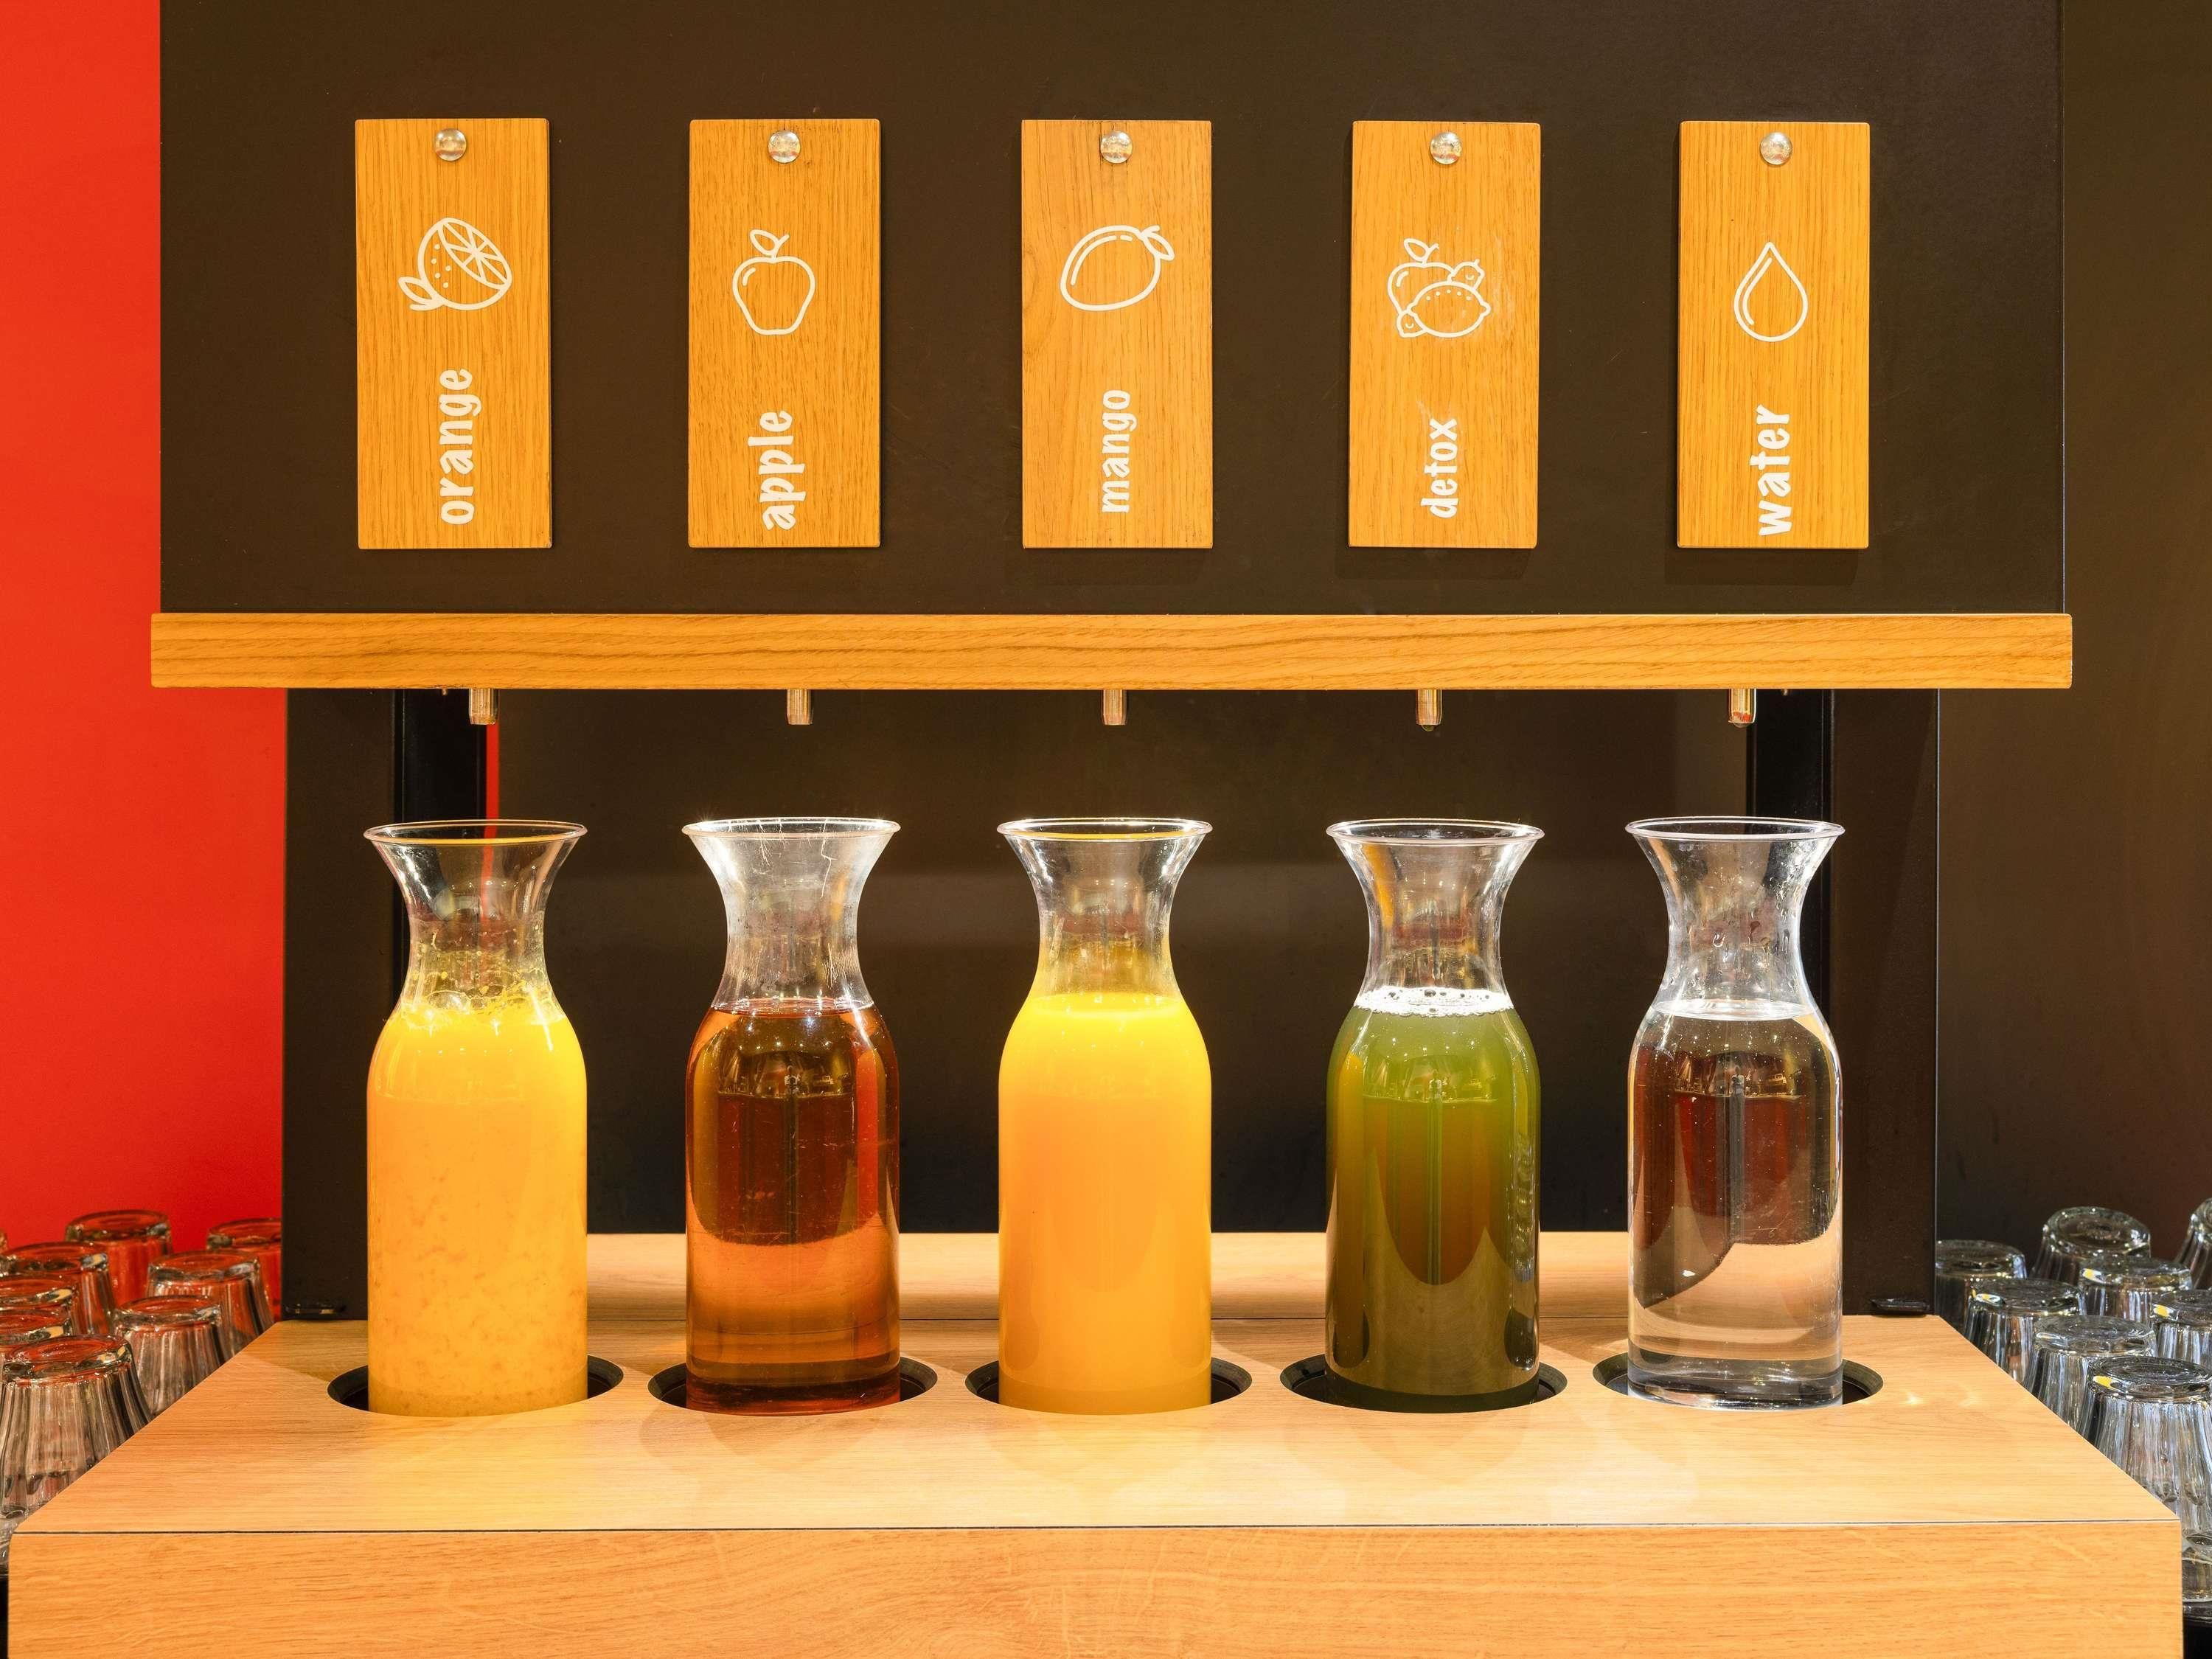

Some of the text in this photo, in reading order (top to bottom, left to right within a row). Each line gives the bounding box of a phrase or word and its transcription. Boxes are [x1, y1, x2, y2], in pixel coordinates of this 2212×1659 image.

[439, 369, 481, 525] orange
[748, 411, 806, 530] apple
[1102, 389, 1138, 513] mango
[1420, 418, 1458, 518] detox
[1750, 405, 1792, 536] water
